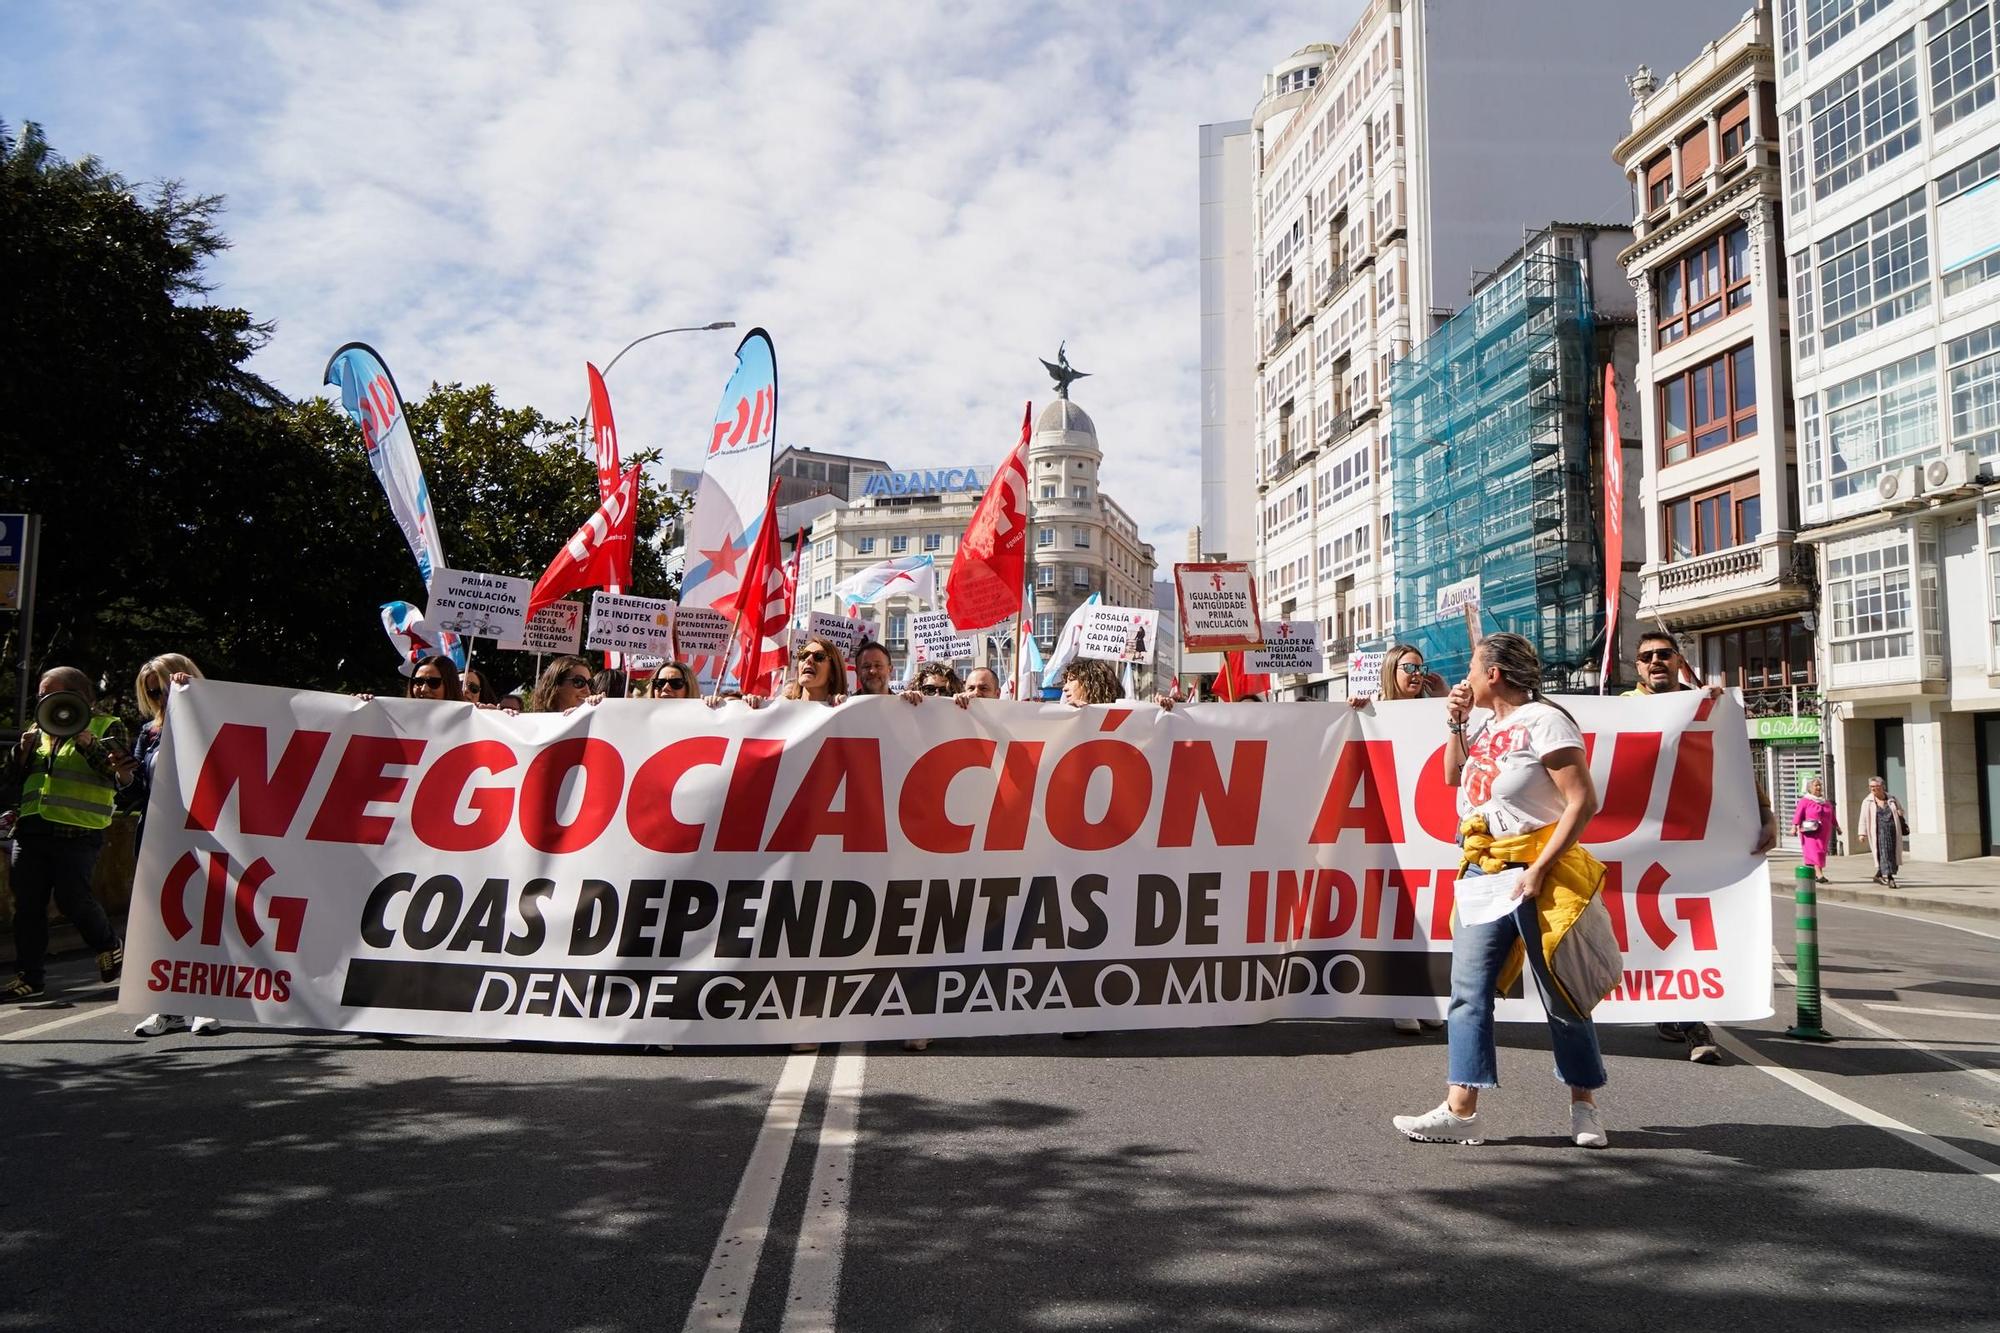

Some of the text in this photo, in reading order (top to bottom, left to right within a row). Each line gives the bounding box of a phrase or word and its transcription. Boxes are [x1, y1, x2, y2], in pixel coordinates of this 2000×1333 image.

[867, 468, 980, 496] ABANCA
[461, 576, 508, 590] PRIMA DE
[448, 587, 517, 604] VINCULACIÓN
[1189, 592, 1247, 601] IGUALDADE NA
[436, 598, 523, 617] SEN CONDICIÓNS.
[597, 596, 667, 611] OS BENEFICIOS
[1192, 600, 1247, 610] ANTIGÜIDADE:
[597, 609, 652, 622] DE INDITEX
[675, 611, 694, 619] OMO
[695, 612, 719, 621] ESTÁN
[1095, 612, 1130, 622] ROSALÍA
[1208, 611, 1234, 619] PRIMA
[677, 620, 728, 630] EPENDENTAS?
[820, 618, 855, 630] ROSALÍA
[913, 621, 948, 632] POR IDADE
[1095, 623, 1128, 633] COMIDA
[1195, 618, 1249, 629] VINCULACIÓN
[616, 624, 667, 638] SÓ OS VEN
[819, 628, 852, 639] COMIDA
[914, 629, 942, 639] PARA AS
[528, 632, 573, 642] CHEGAMOS
[1087, 633, 1125, 644] CADA DÍA
[1302, 638, 1315, 646] NA
[530, 640, 557, 649] VELLEZ
[590, 637, 648, 650] DOUS OU TRES
[681, 641, 717, 650] TRA TRÁ!
[836, 640, 849, 649] DÍA
[929, 643, 945, 652] NON
[951, 641, 971, 649] UNHA
[1086, 643, 1122, 654] TRA TRÁ!
[936, 649, 972, 659] REALIDADE
[1270, 653, 1297, 661] PRIMA
[1255, 660, 1313, 668] VINCULACIÓN
[185, 709, 1268, 854] NEGOCIACIÓN
[160, 850, 308, 952] CIG
[360, 872, 556, 957] COAS
[568, 872, 1109, 959] DEPENDENTAS
[1135, 872, 1222, 947] DE
[147, 958, 292, 1003] SERVIZOS
[471, 953, 1367, 1021] DENDE GALIZA PARA O MUNDO
